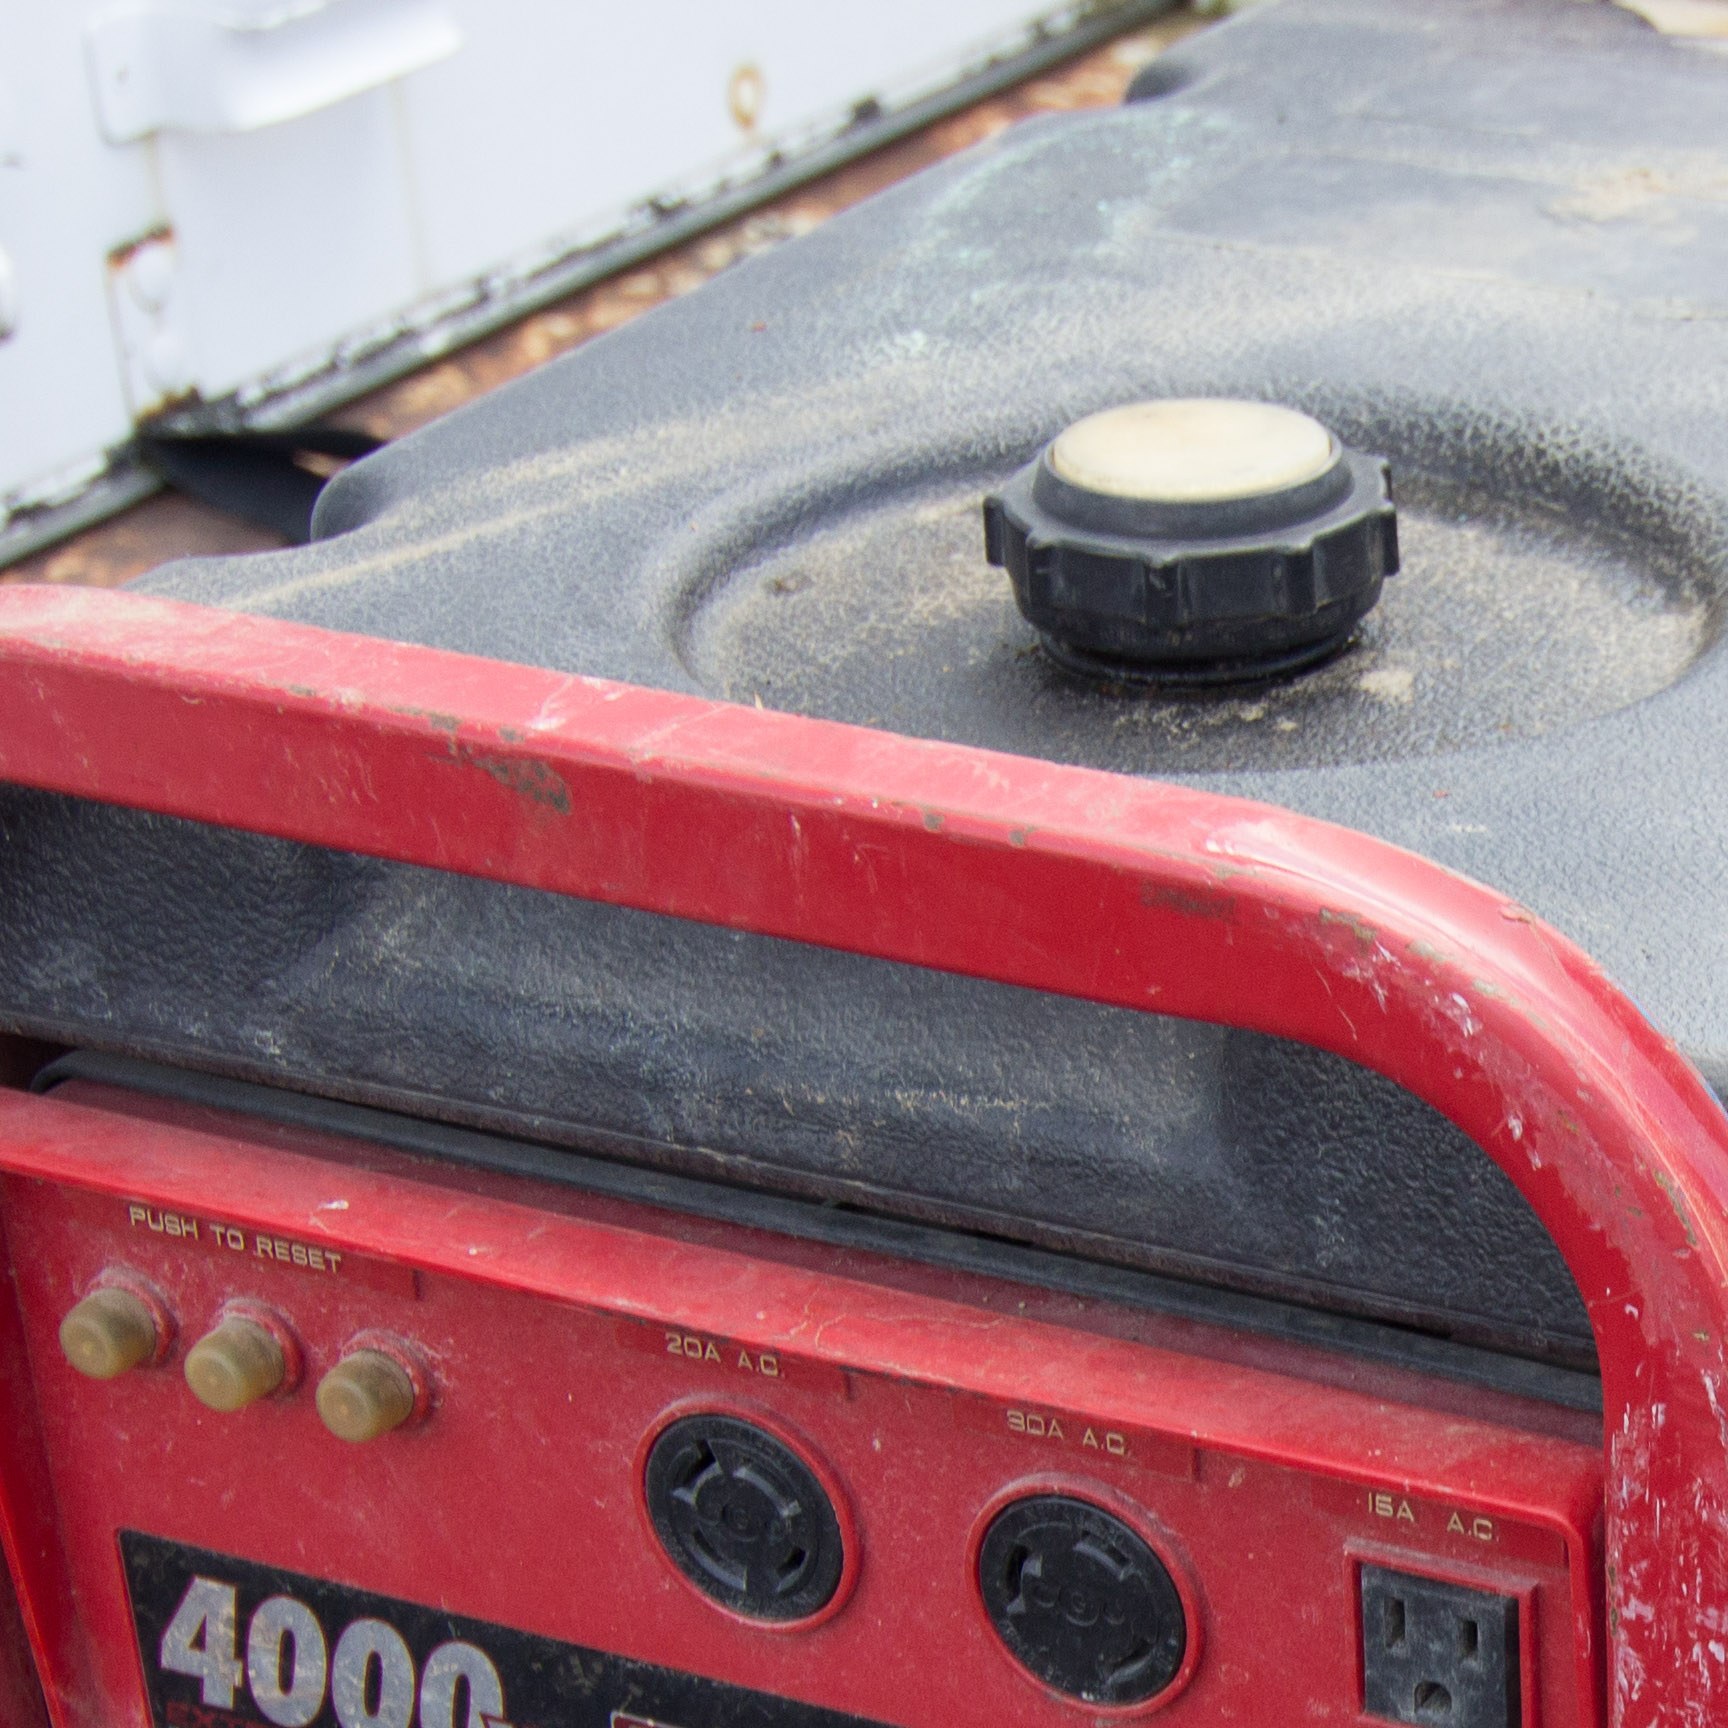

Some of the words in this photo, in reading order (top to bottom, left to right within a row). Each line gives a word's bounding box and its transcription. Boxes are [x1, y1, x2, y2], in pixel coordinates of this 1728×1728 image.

[129, 1206, 198, 1240] PUSH
[209, 1223, 245, 1250] TO
[256, 1235, 341, 1273] RESET
[665, 1332, 721, 1363] 20A
[738, 1349, 785, 1379] A.C.
[1006, 1408, 1064, 1440] 30A
[1369, 1491, 1415, 1523] 15A
[1447, 1512, 1499, 1541] A.C.
